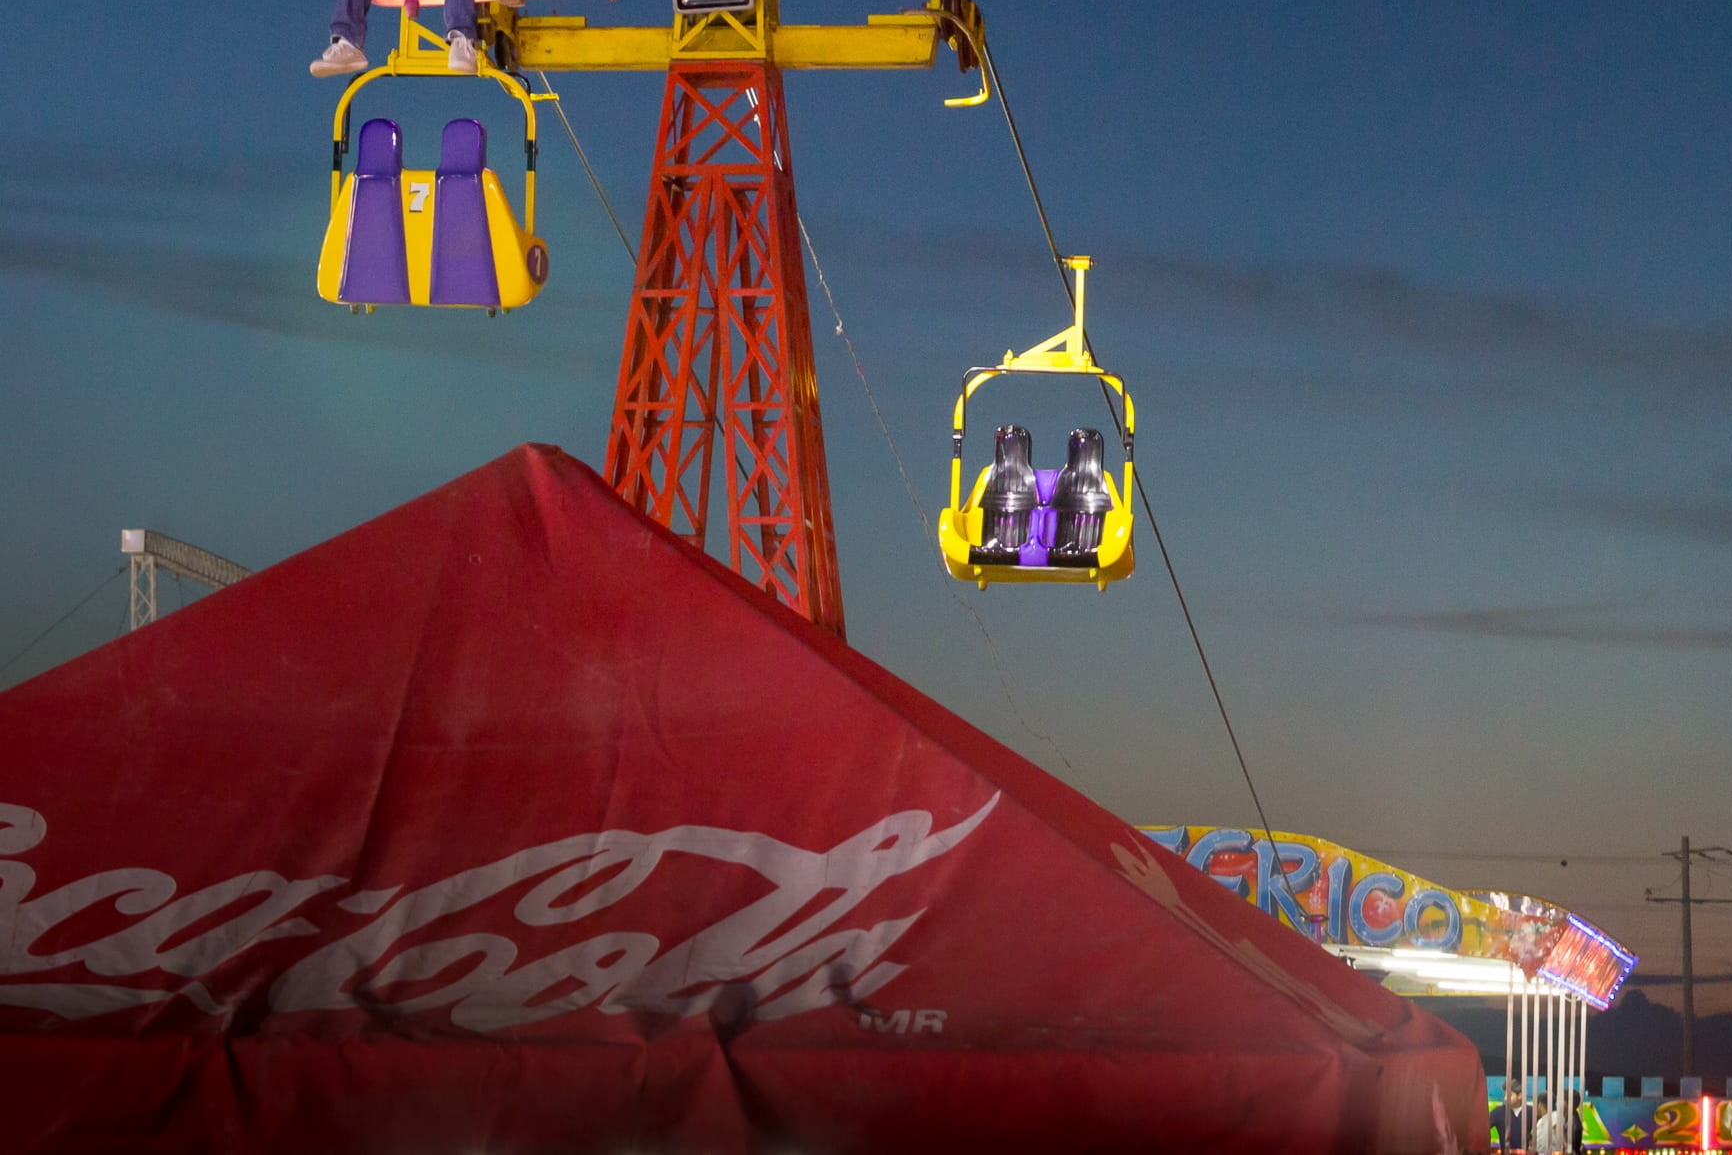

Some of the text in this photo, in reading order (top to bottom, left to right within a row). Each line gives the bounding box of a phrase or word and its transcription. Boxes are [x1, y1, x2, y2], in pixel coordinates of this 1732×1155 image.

[408, 181, 430, 212] 7
[0, 790, 1001, 1030] ca-Cola
[859, 1009, 948, 1034] MR
